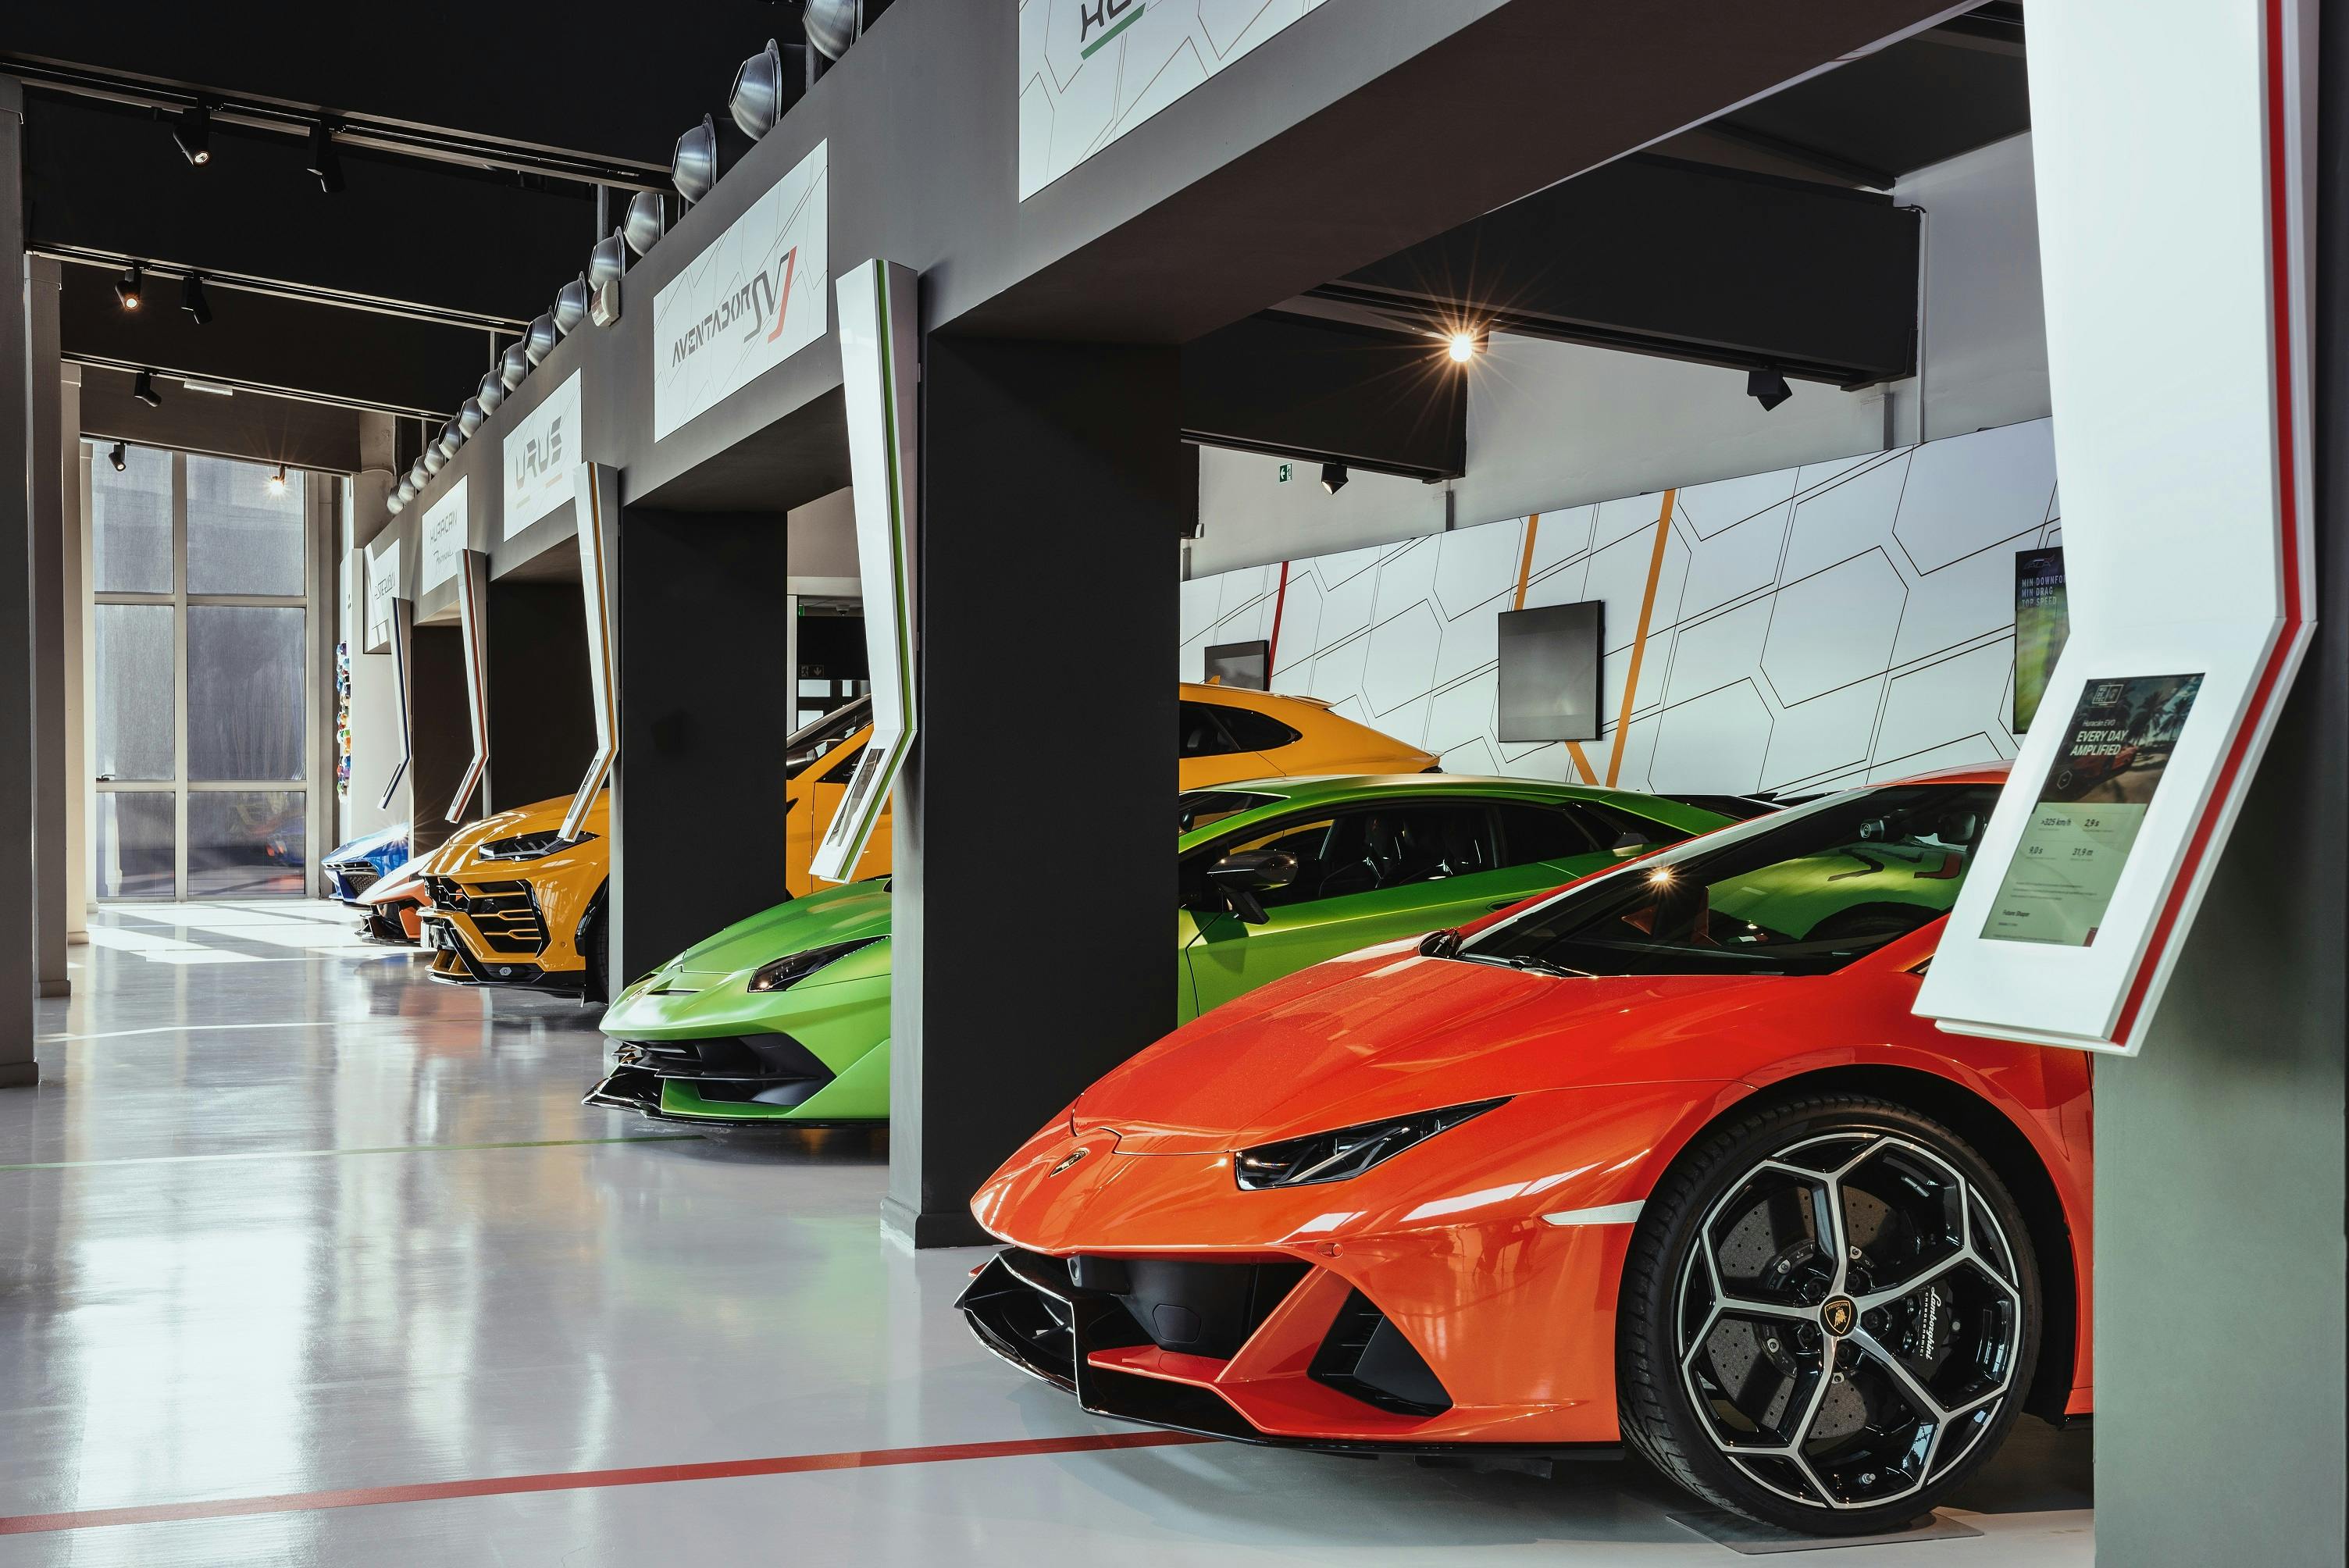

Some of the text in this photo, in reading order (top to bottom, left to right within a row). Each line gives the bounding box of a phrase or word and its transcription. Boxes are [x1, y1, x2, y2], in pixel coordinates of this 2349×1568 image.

[672, 246, 797, 368] AVENTADOR SVJ
[2022, 578, 2034, 587] MIN
[2022, 586, 2053, 598] MIN DRAG
[2036, 597, 2057, 606] SPEED
[2076, 729, 2130, 742] EVERY DAY
[2069, 744, 2122, 756] AMPLIFIED
[1926, 1287, 1941, 1360] Lamborghini
